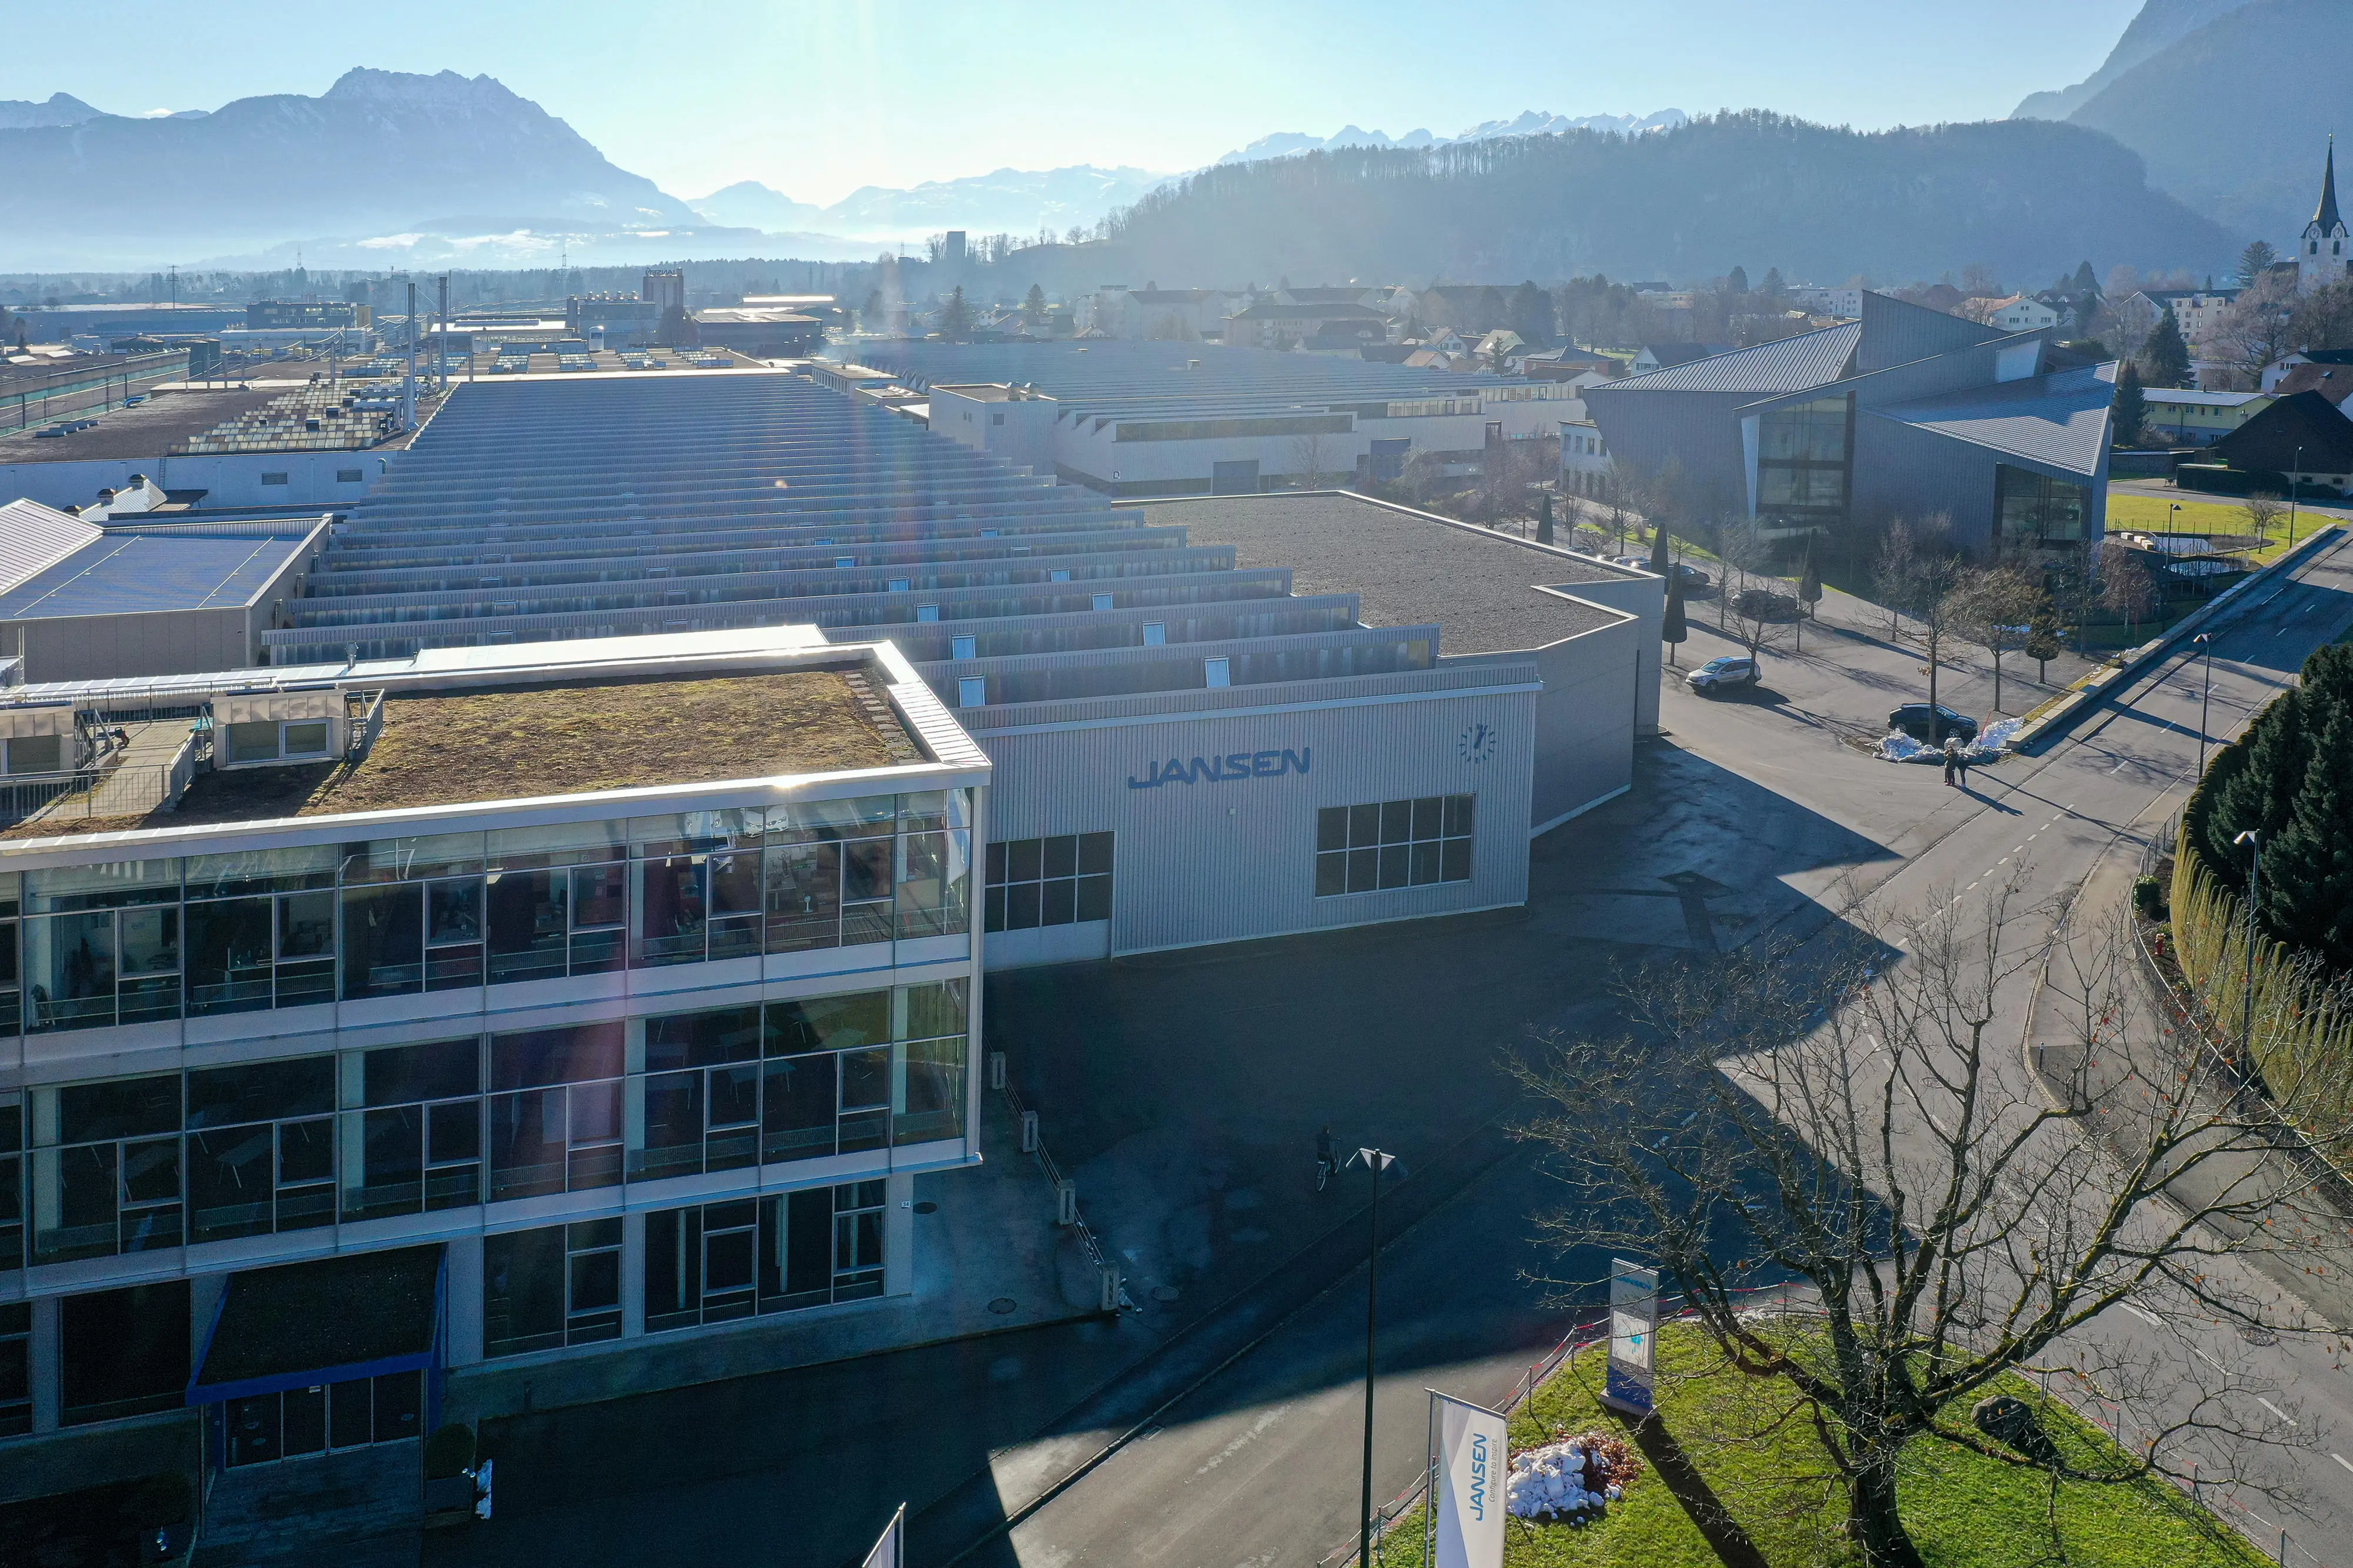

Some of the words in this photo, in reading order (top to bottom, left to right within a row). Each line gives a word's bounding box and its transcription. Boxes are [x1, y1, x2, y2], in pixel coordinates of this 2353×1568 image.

[1128, 748, 1310, 789] JANSEN
[1470, 1433, 1487, 1521] JANSEN
[1488, 1470, 1497, 1502] Configure
